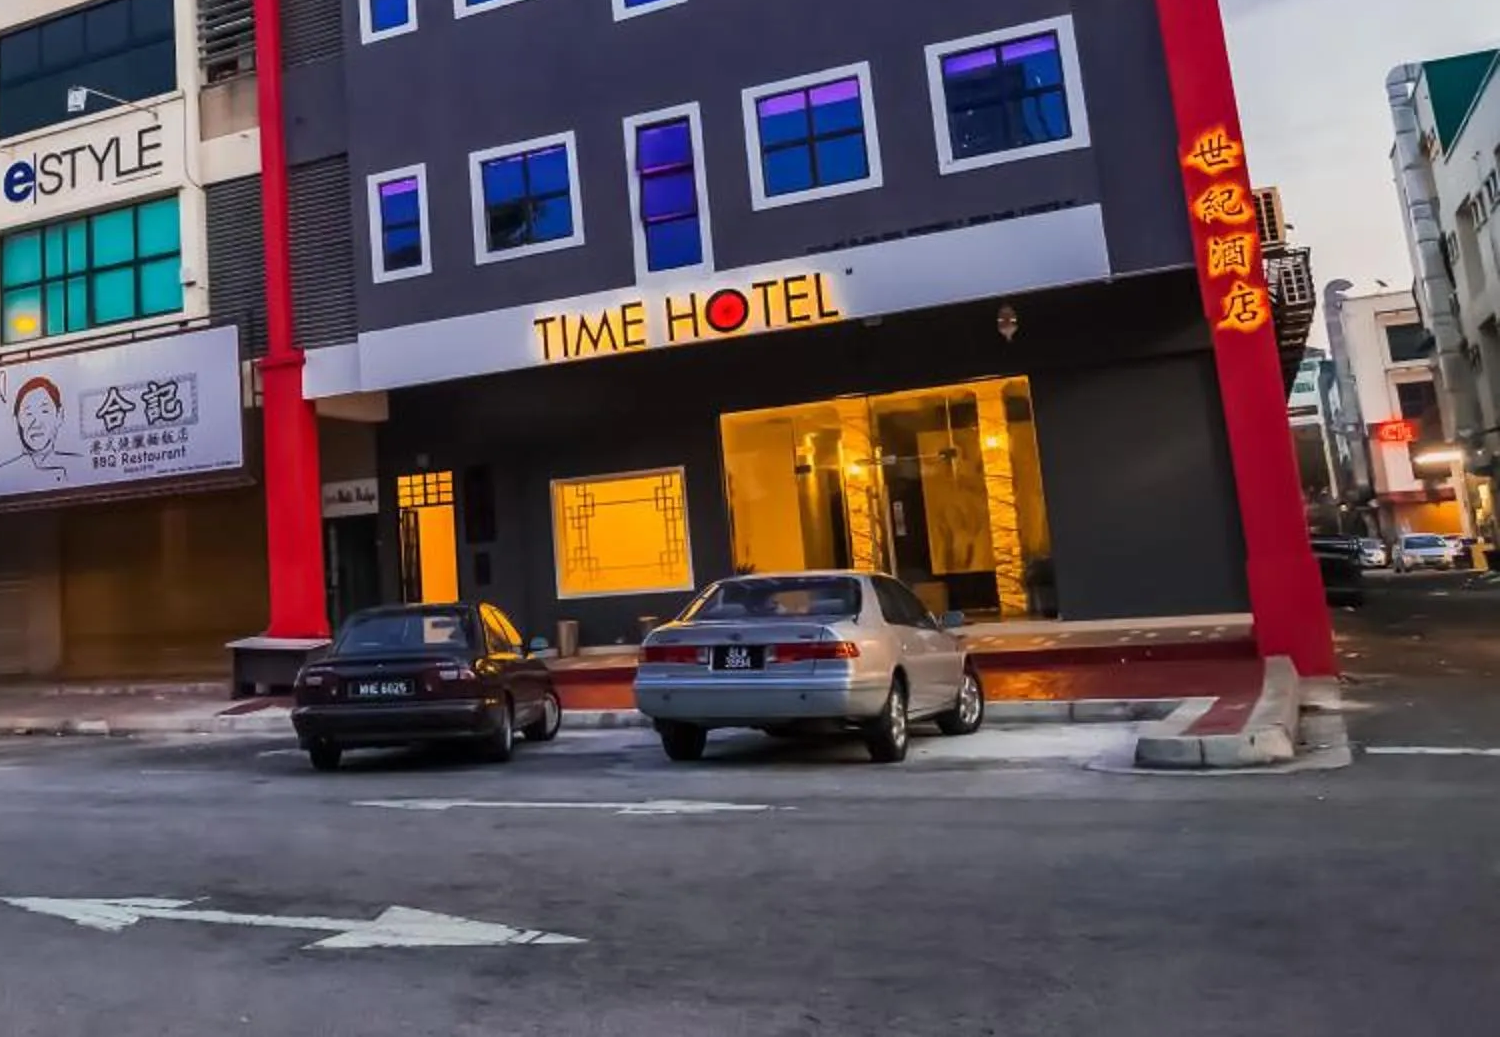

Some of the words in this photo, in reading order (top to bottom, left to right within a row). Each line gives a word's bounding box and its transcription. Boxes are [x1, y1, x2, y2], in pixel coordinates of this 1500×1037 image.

[1193, 134, 1260, 324] 世紀酒店
[534, 301, 645, 360] TIME
[665, 272, 840, 342] HOTEL
[96, 380, 184, 432] 合記
